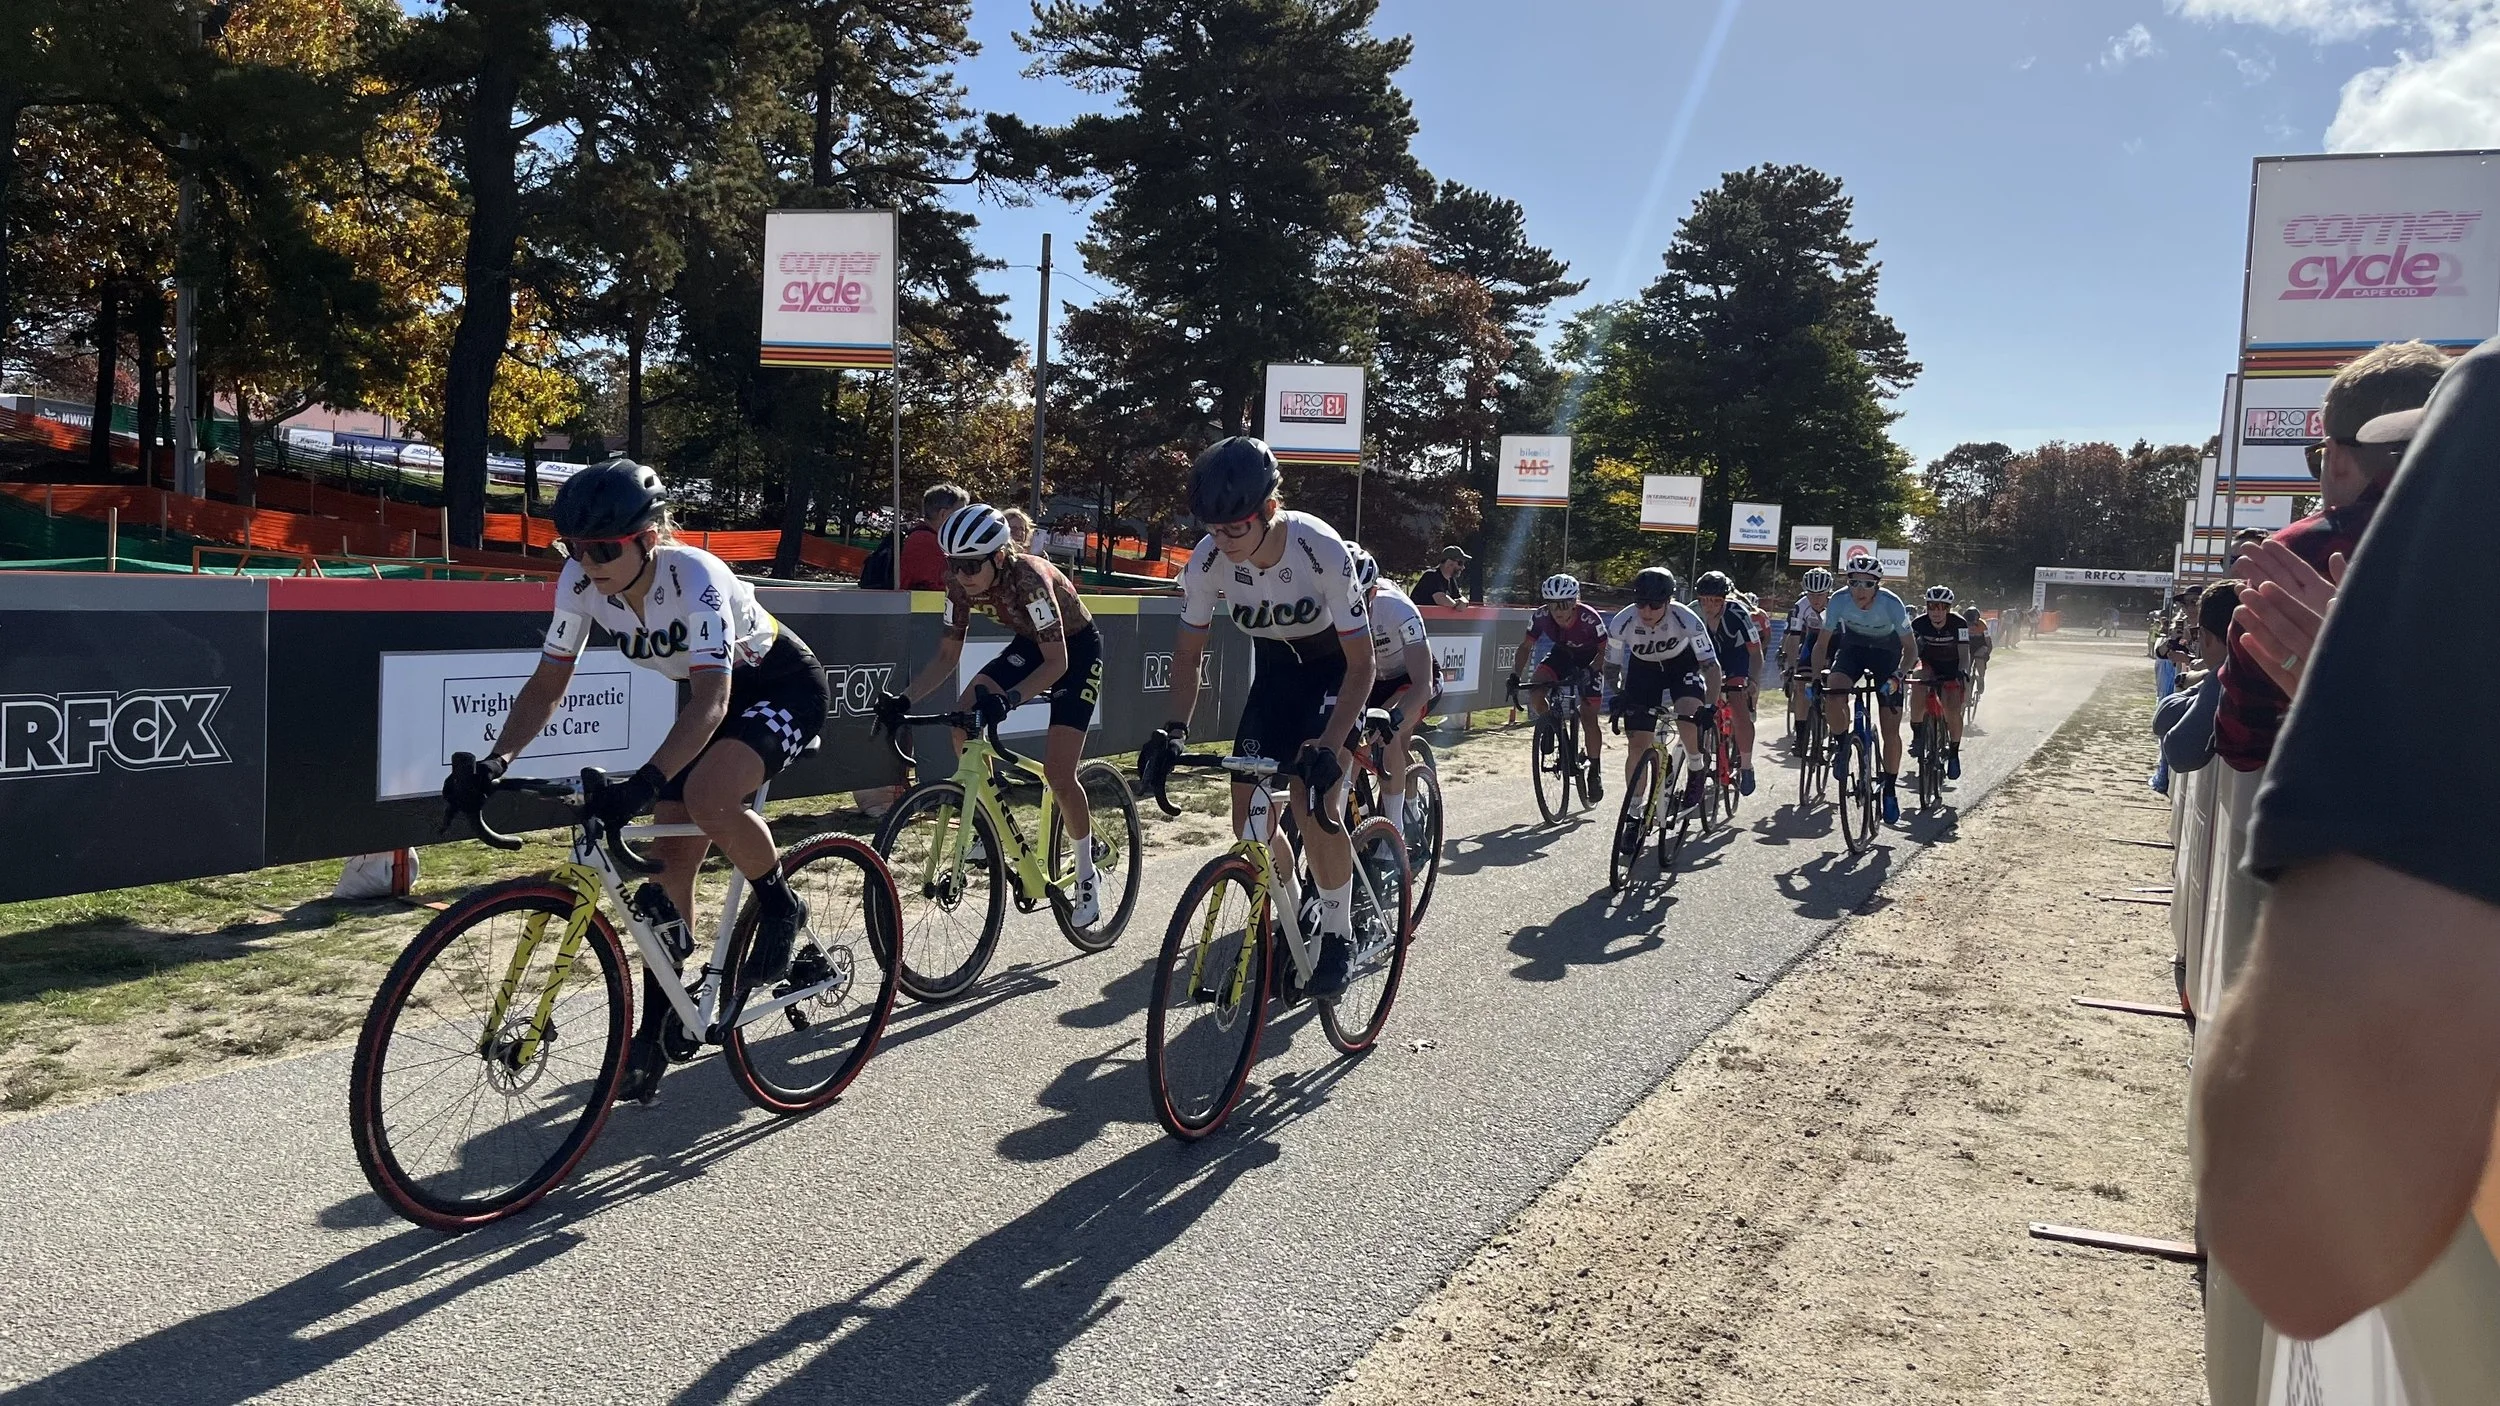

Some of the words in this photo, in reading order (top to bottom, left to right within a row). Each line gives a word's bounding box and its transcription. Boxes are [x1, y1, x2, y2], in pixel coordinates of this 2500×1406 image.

[2287, 244, 2441, 300] cycle
[782, 275, 862, 312] cycle
[2352, 288, 2388, 298] CAPE
[2390, 287, 2419, 297] COD
[1294, 393, 1324, 408] PRO
[1283, 403, 1323, 416] thirteen
[2265, 410, 2306, 426] PRO
[2248, 423, 2304, 437] thirteen
[1518, 459, 1549, 475] MS
[1812, 543, 1828, 551] CX
[2038, 571, 2057, 580] START
[2084, 570, 2126, 581] RRFCX
[2155, 576, 2171, 584] STAR
[1034, 606, 1045, 621] 2
[1231, 596, 1322, 629] nice
[556, 620, 567, 639] 4
[700, 620, 710, 641] 4
[1407, 625, 1416, 636] 5
[609, 618, 690, 660] nice
[1632, 636, 1680, 656] nice
[451, 692, 515, 717] Wright
[0, 690, 226, 775] RFCX
[483, 722, 497, 742] &
[562, 717, 601, 736] Care
